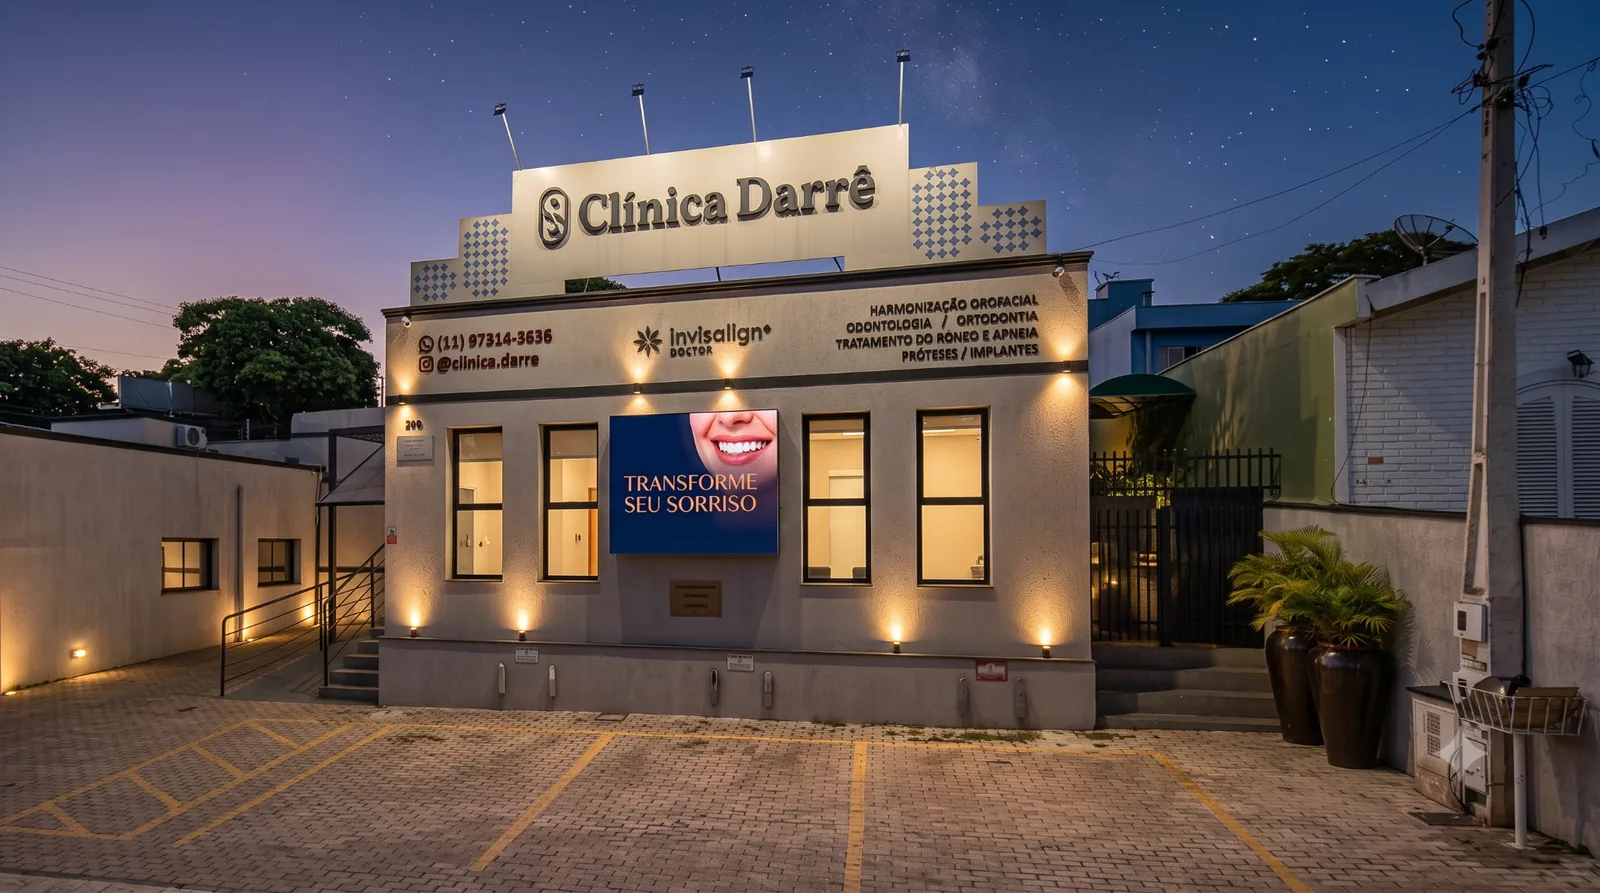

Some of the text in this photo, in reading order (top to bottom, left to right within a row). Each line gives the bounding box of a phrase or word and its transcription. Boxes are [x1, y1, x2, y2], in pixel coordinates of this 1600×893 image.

[578, 165, 876, 235] Clínica Darrê
[870, 294, 1038, 317] HARMONIZAÇÃO OROFACIAL
[846, 311, 1038, 334] ODONTOLOGIA / ORTODONTIA
[437, 328, 553, 353] (11) 97314-3636
[670, 323, 763, 346] invisalign
[836, 335, 913, 350] TRATAMENTO
[916, 333, 933, 346] DO
[982, 330, 990, 342] E
[993, 327, 1038, 341] APNEIA
[670, 346, 713, 358] DOCTOR
[902, 343, 1039, 363] PRÓTESES / IMPLANTES
[623, 473, 758, 492] TRANSFORME
[624, 494, 757, 513] SEU SORRISO
